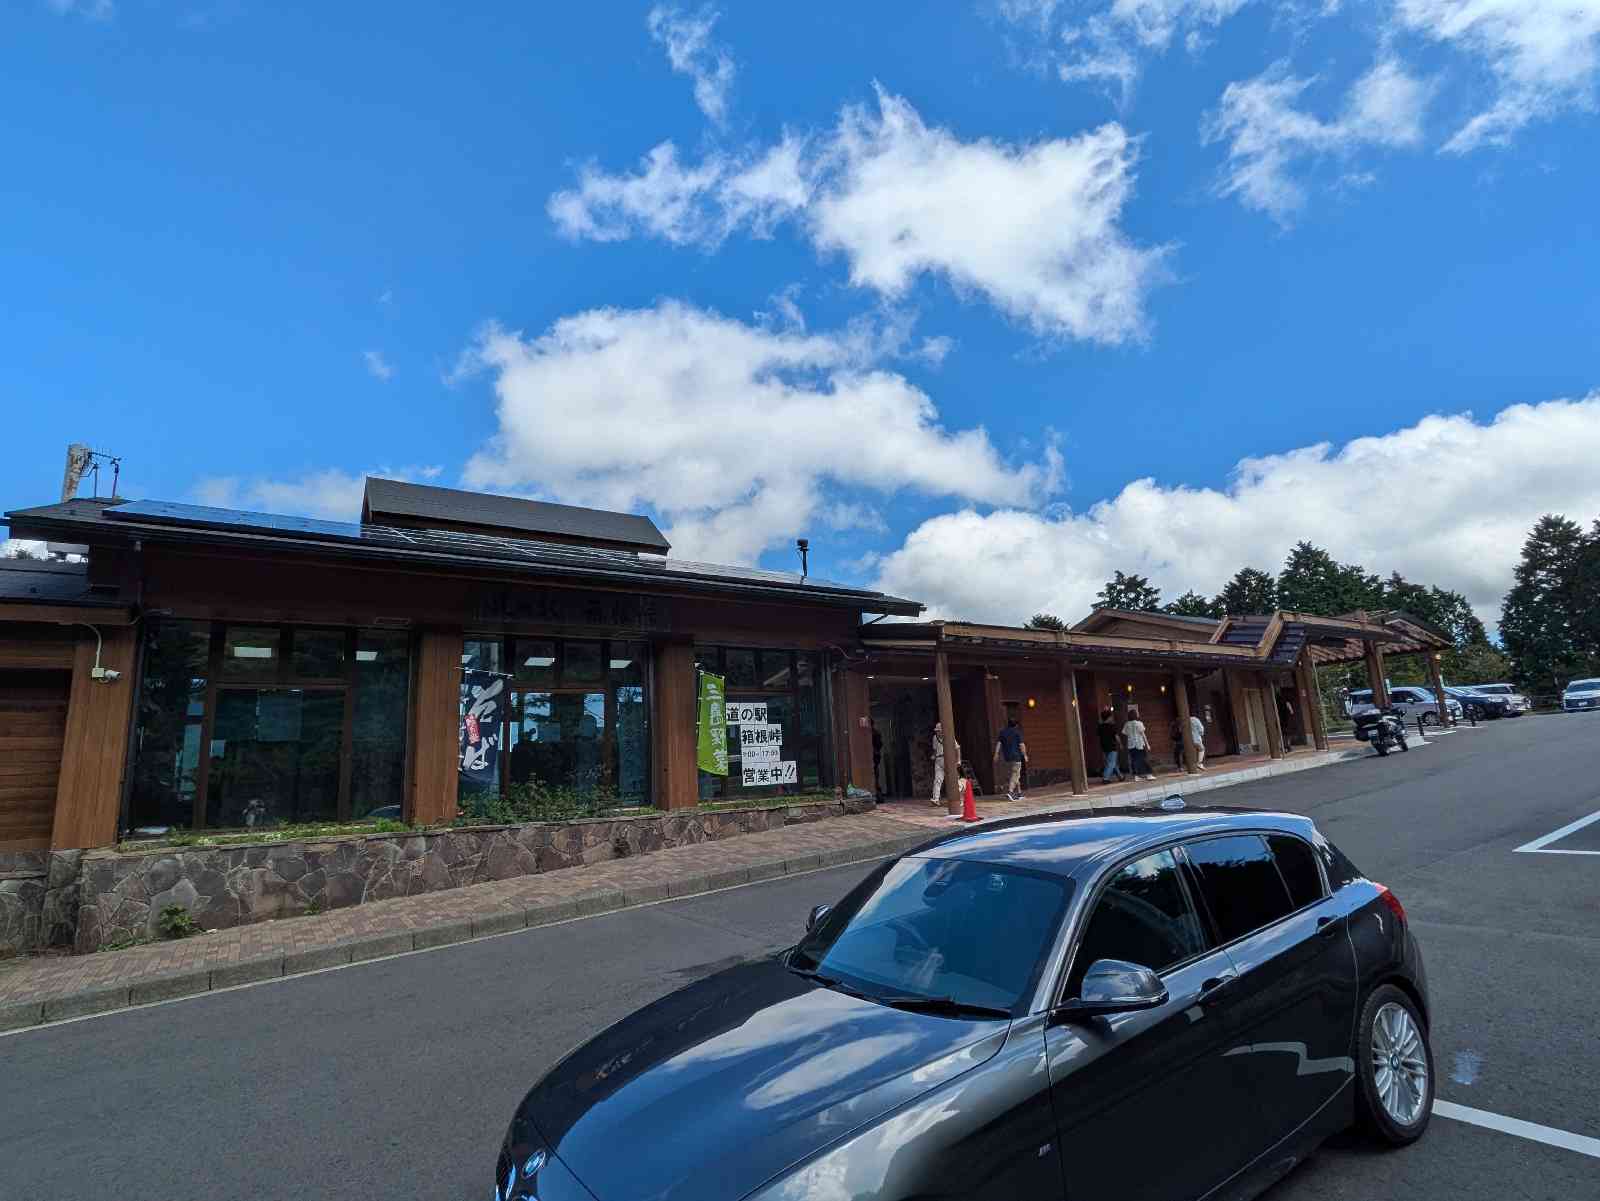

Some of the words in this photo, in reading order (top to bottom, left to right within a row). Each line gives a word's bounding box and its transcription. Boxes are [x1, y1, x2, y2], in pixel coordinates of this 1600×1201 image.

[727, 707, 767, 721] 道の駅
[742, 729, 782, 744] 箱根峠
